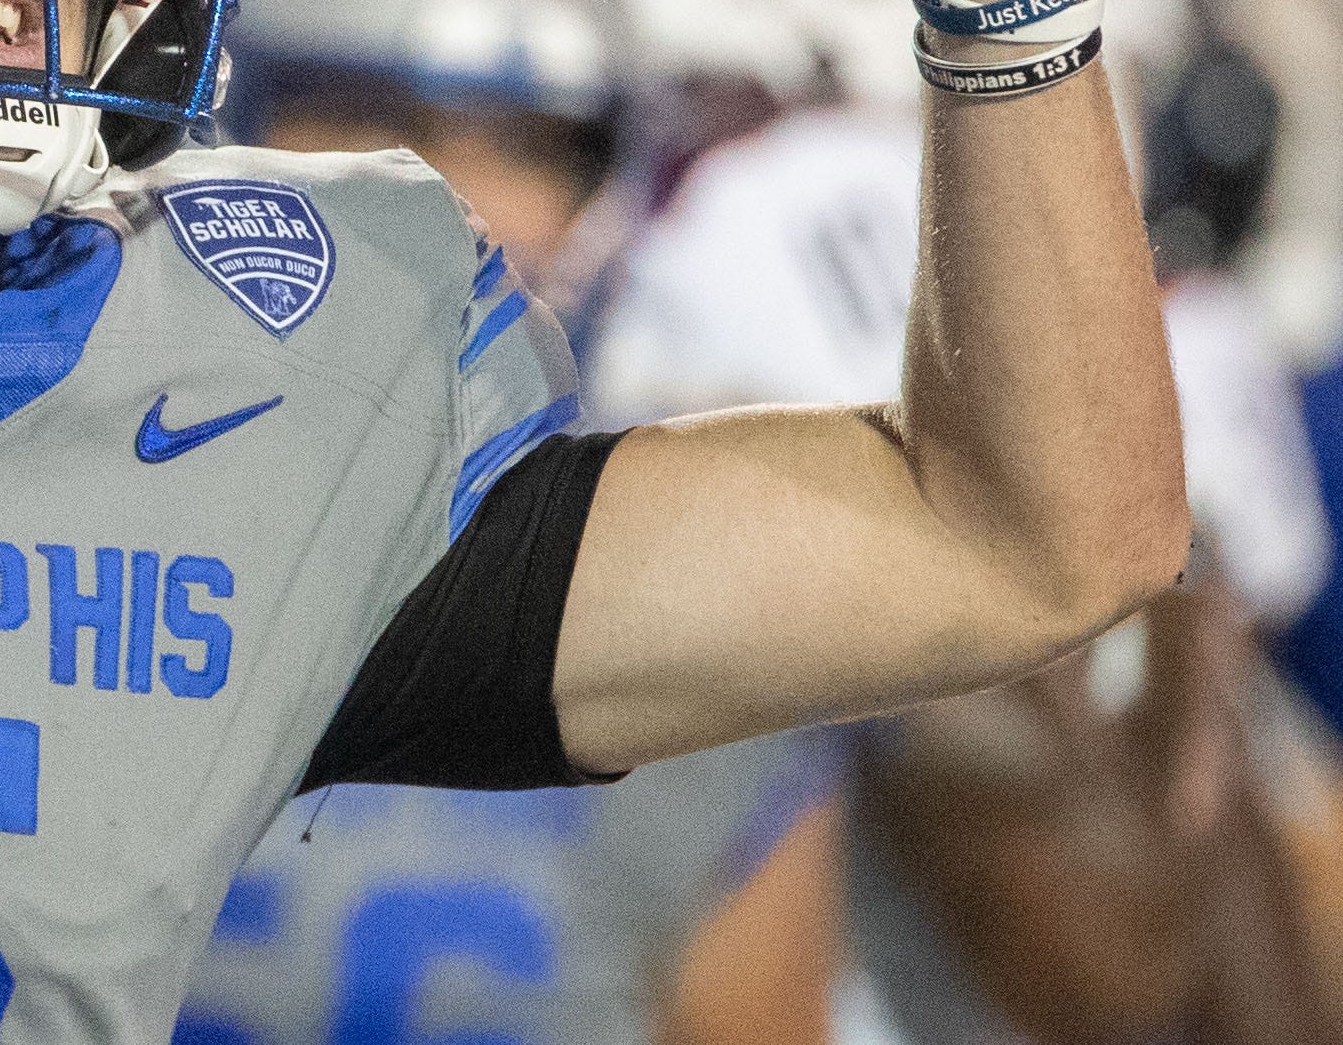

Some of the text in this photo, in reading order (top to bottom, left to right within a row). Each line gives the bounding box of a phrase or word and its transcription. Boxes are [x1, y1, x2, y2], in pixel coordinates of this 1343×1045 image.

[192, 197, 287, 218] TIGER
[189, 217, 314, 242] SCHOLAR
[218, 255, 316, 278] NON DUCOR DUCO
